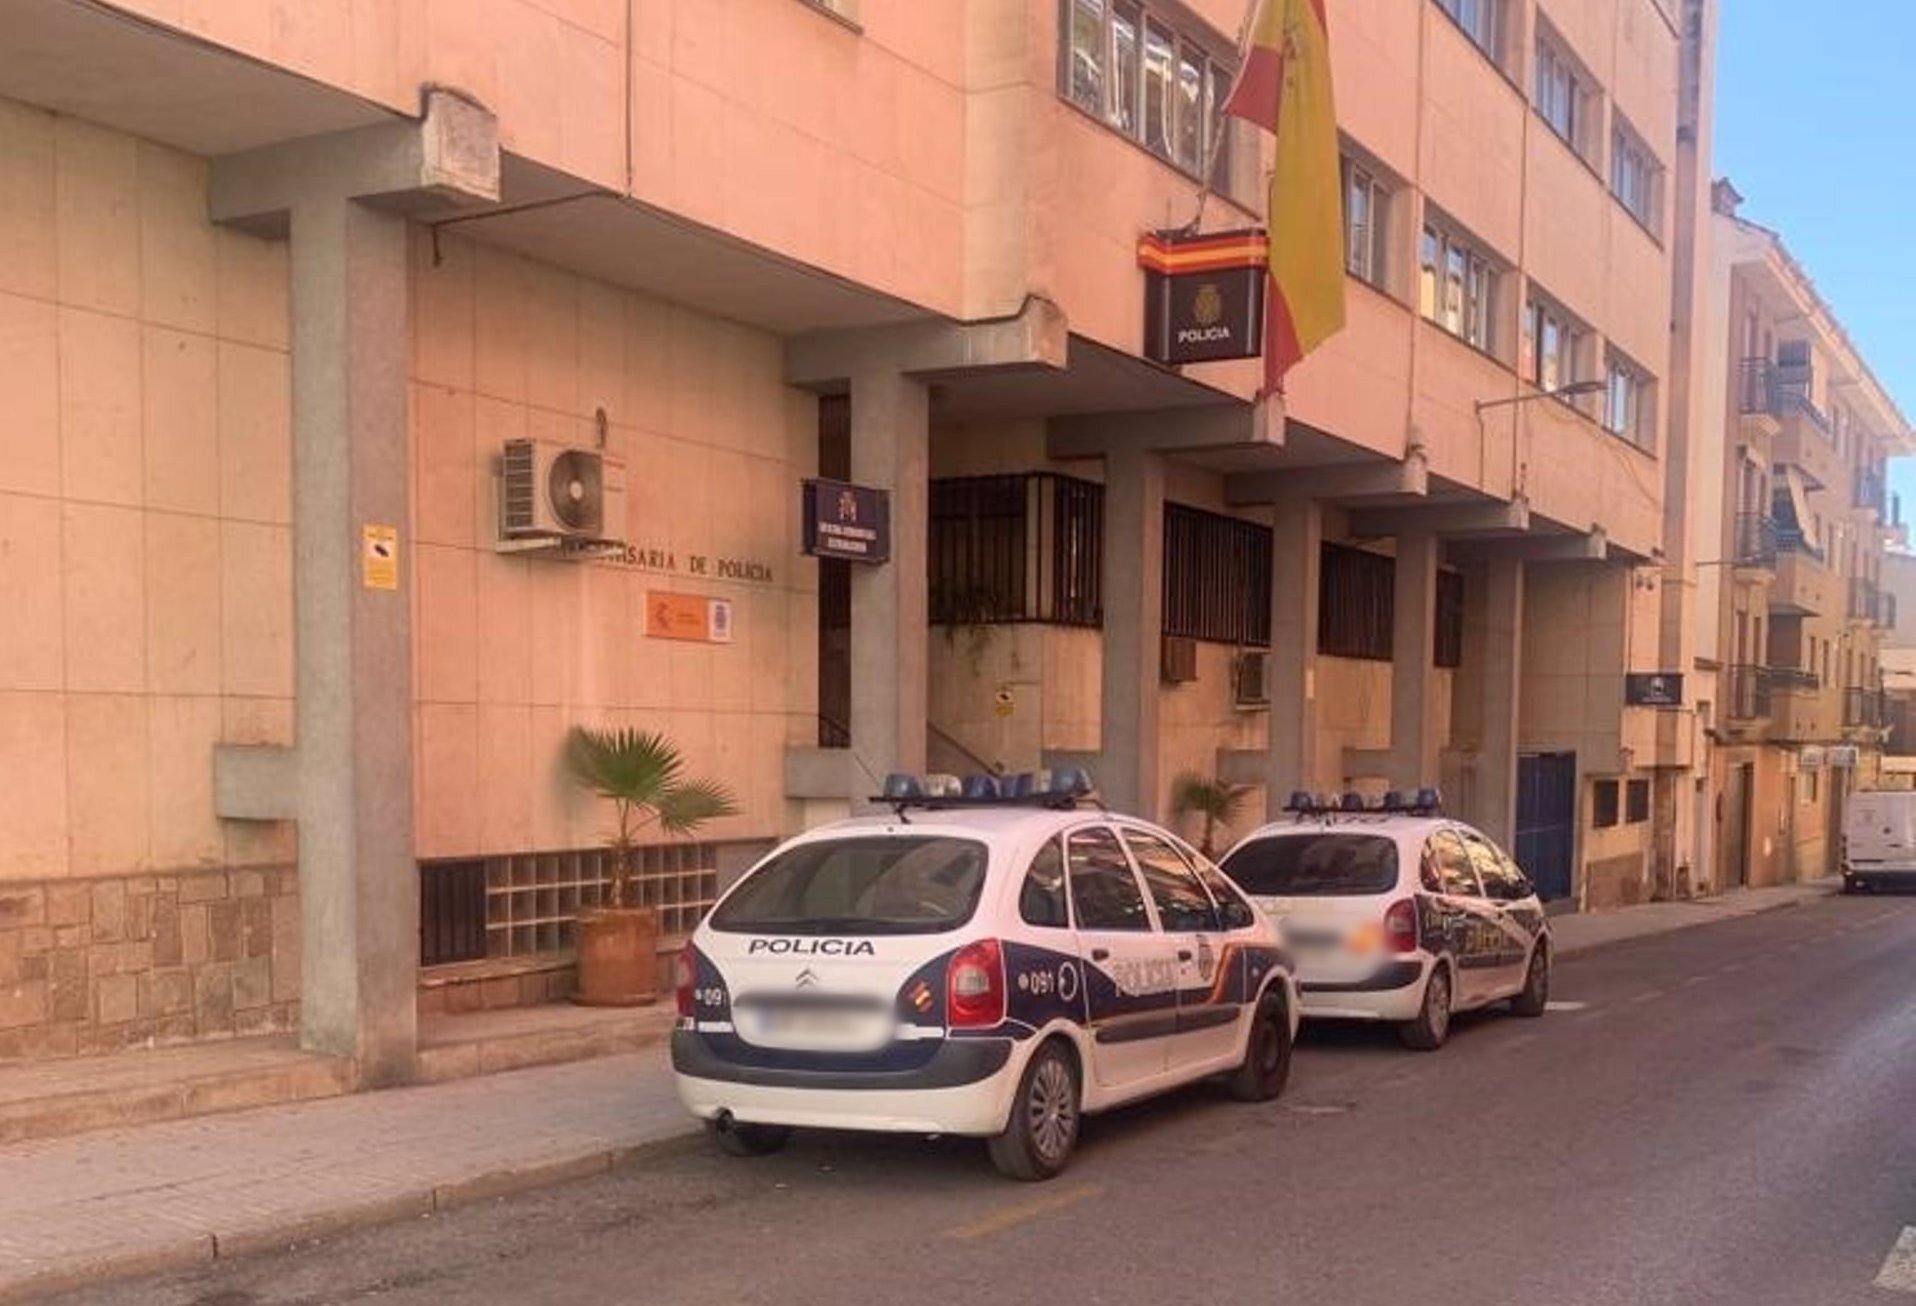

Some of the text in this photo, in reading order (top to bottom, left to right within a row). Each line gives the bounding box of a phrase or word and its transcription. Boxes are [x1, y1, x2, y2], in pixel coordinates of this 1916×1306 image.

[1178, 326, 1230, 343] POLICIA
[689, 556, 707, 575] DE
[717, 558, 773, 582] POLICIA
[748, 938, 875, 956] POLICIA
[1031, 971, 1054, 995] 091
